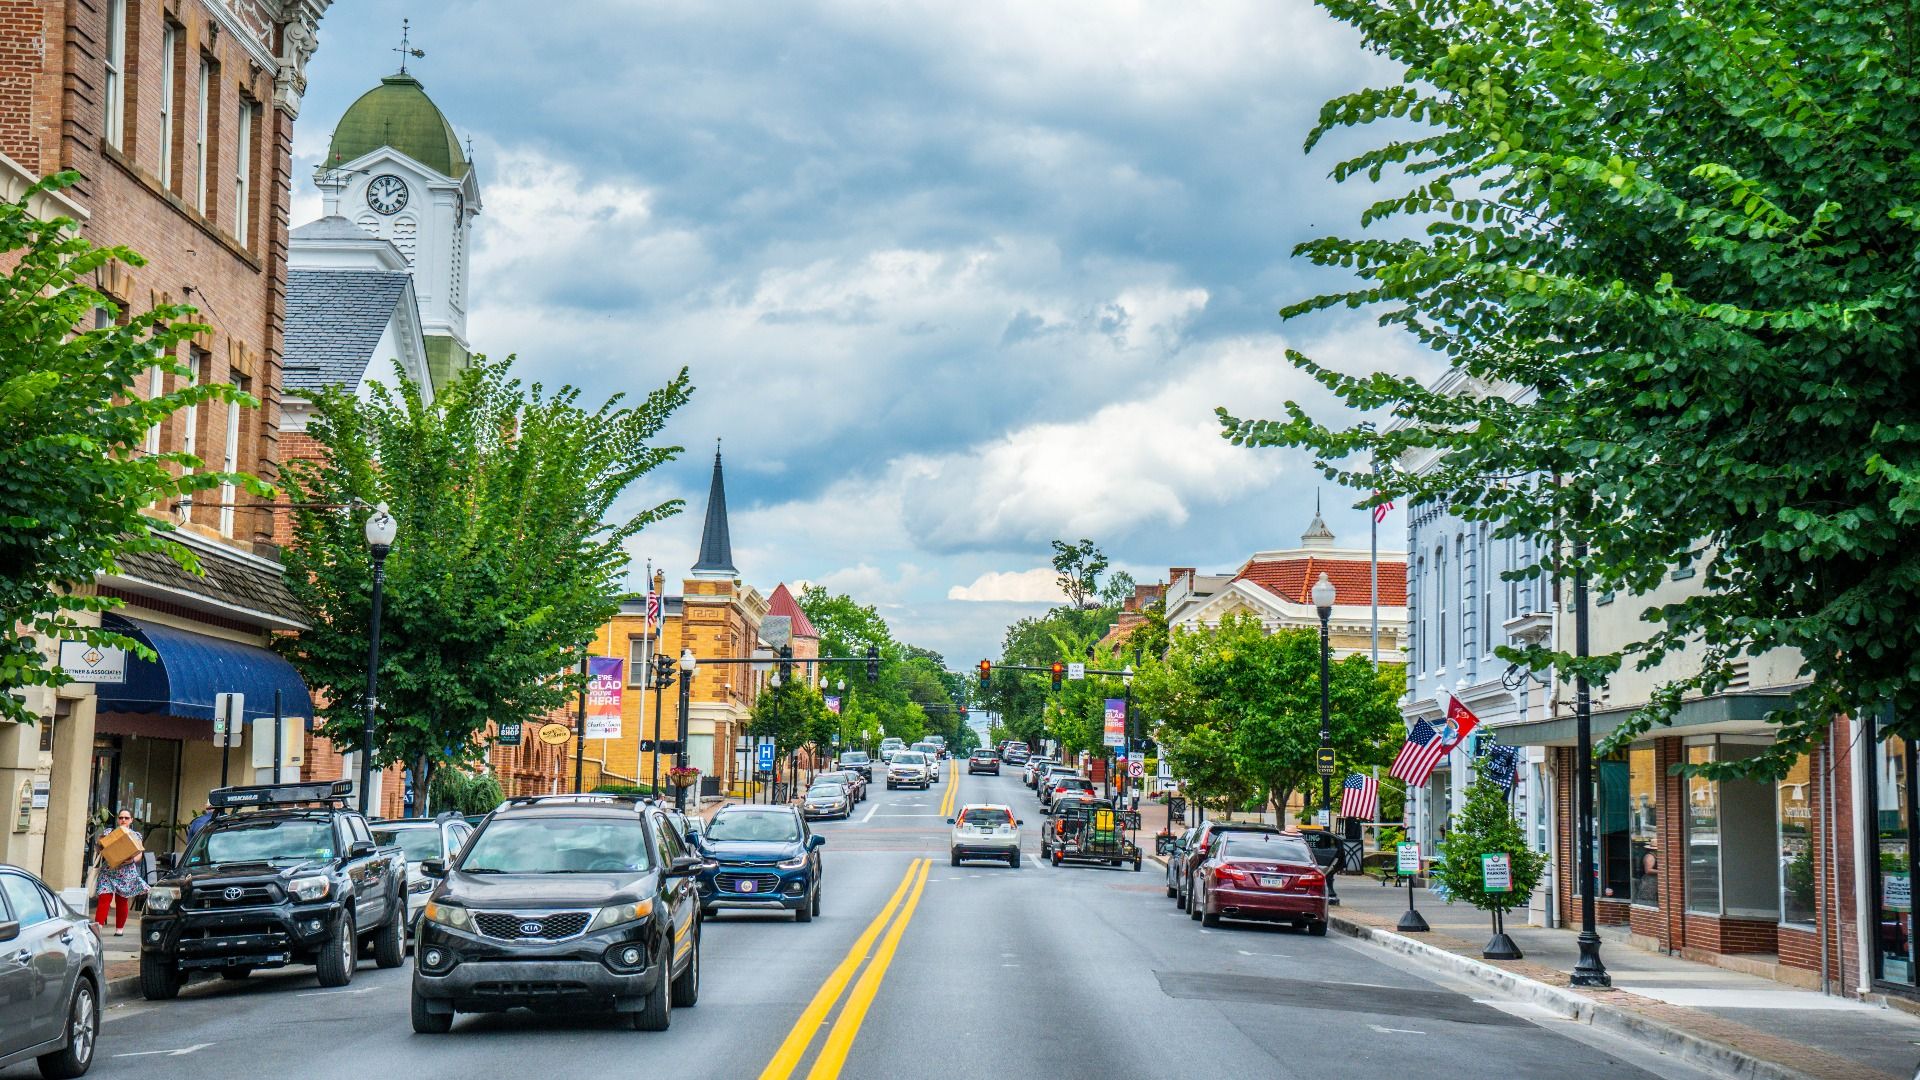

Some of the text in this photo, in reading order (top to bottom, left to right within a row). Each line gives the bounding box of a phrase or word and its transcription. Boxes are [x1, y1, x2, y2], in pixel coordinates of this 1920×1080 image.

[590, 681, 622, 690] GLAD
[589, 697, 620, 706] HERE
[762, 746, 771, 759] H
